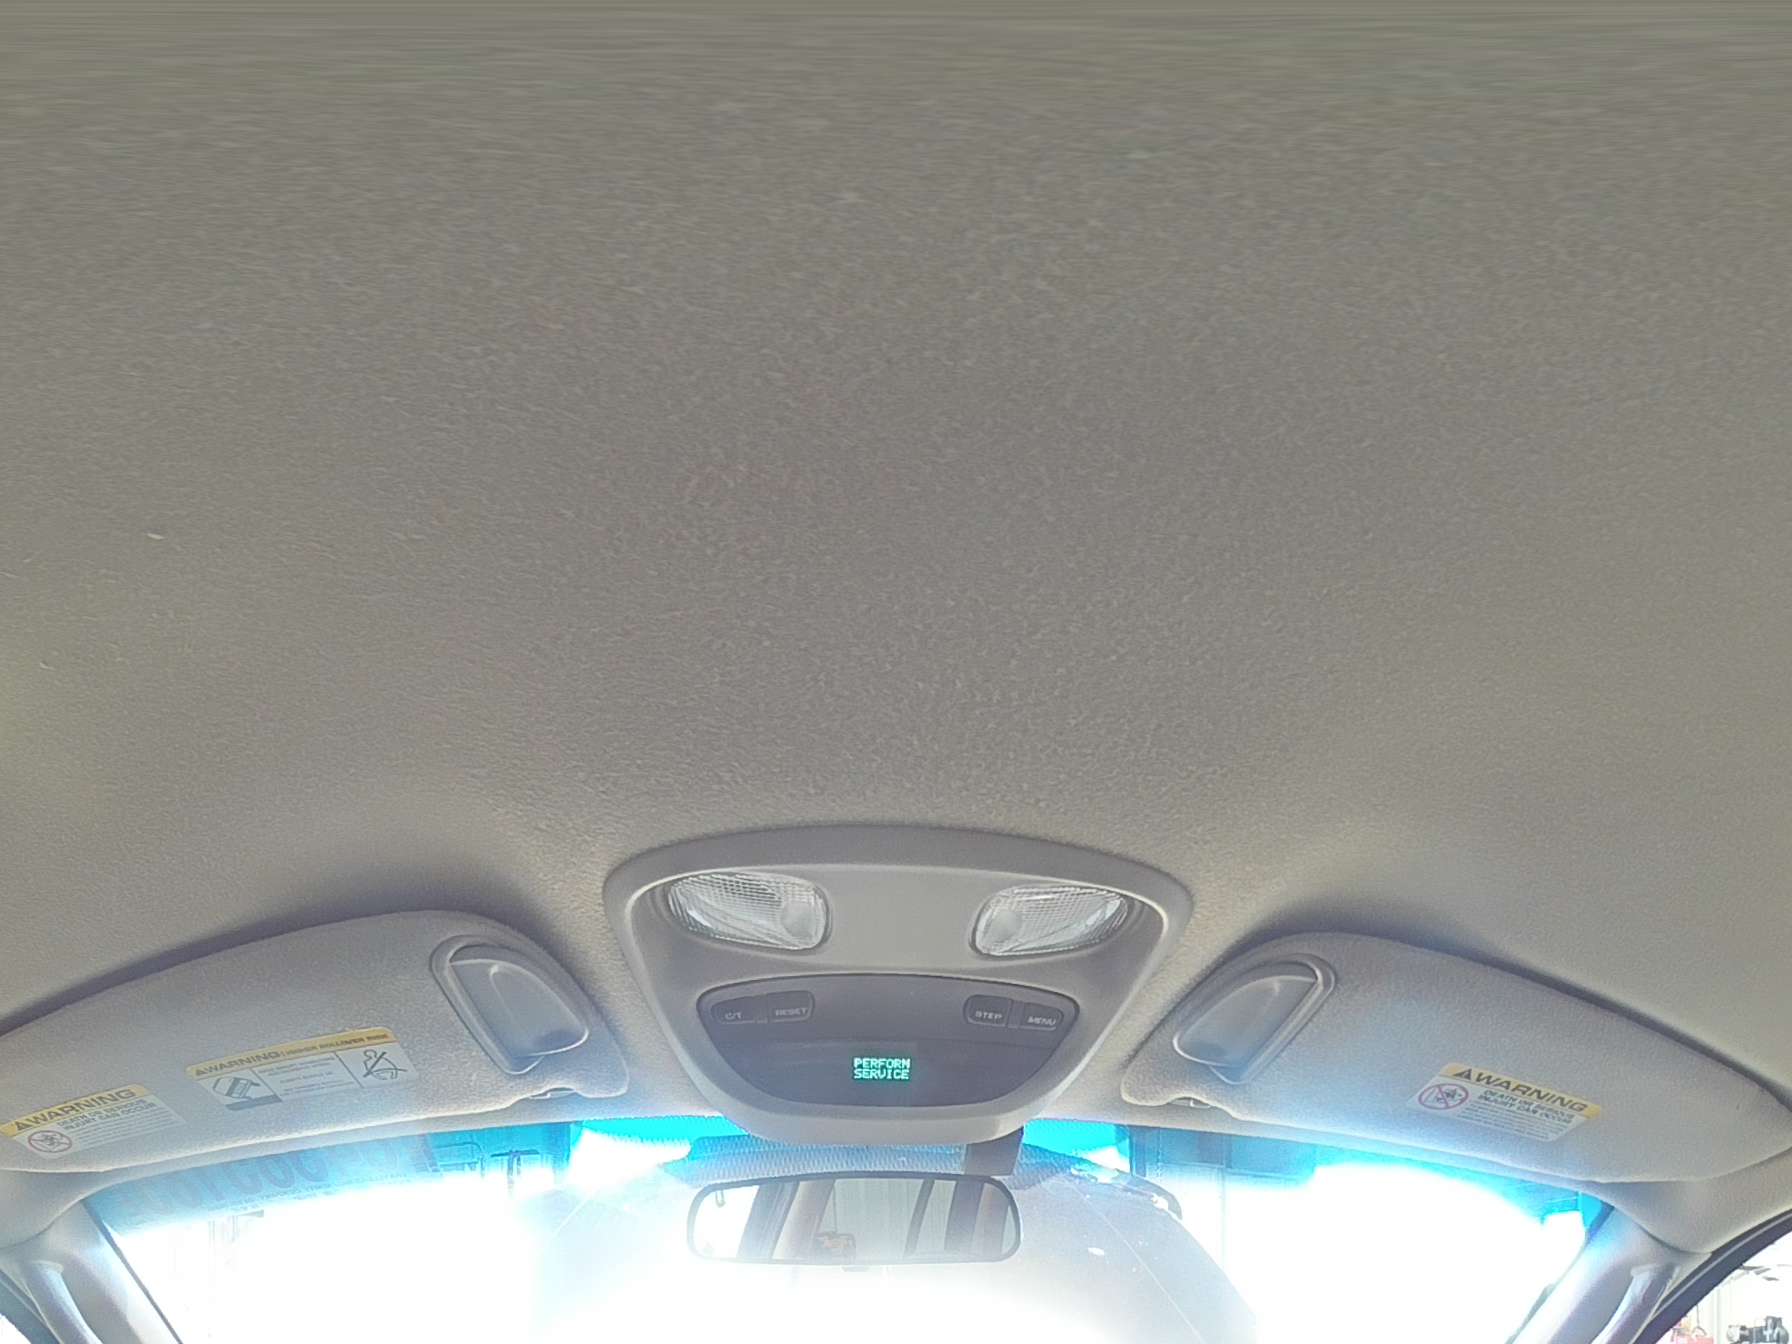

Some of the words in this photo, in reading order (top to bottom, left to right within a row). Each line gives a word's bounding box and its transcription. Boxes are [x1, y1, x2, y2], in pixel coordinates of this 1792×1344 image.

[774, 1007, 808, 1017] RESET
[975, 1010, 1003, 1021] STEP
[1028, 1016, 1057, 1027] MENU
[853, 1057, 911, 1069] PERFORM
[853, 1068, 910, 1080] SERVICE
[1475, 1072, 1589, 1113] WARNING
[26, 1088, 137, 1126] WARNING
